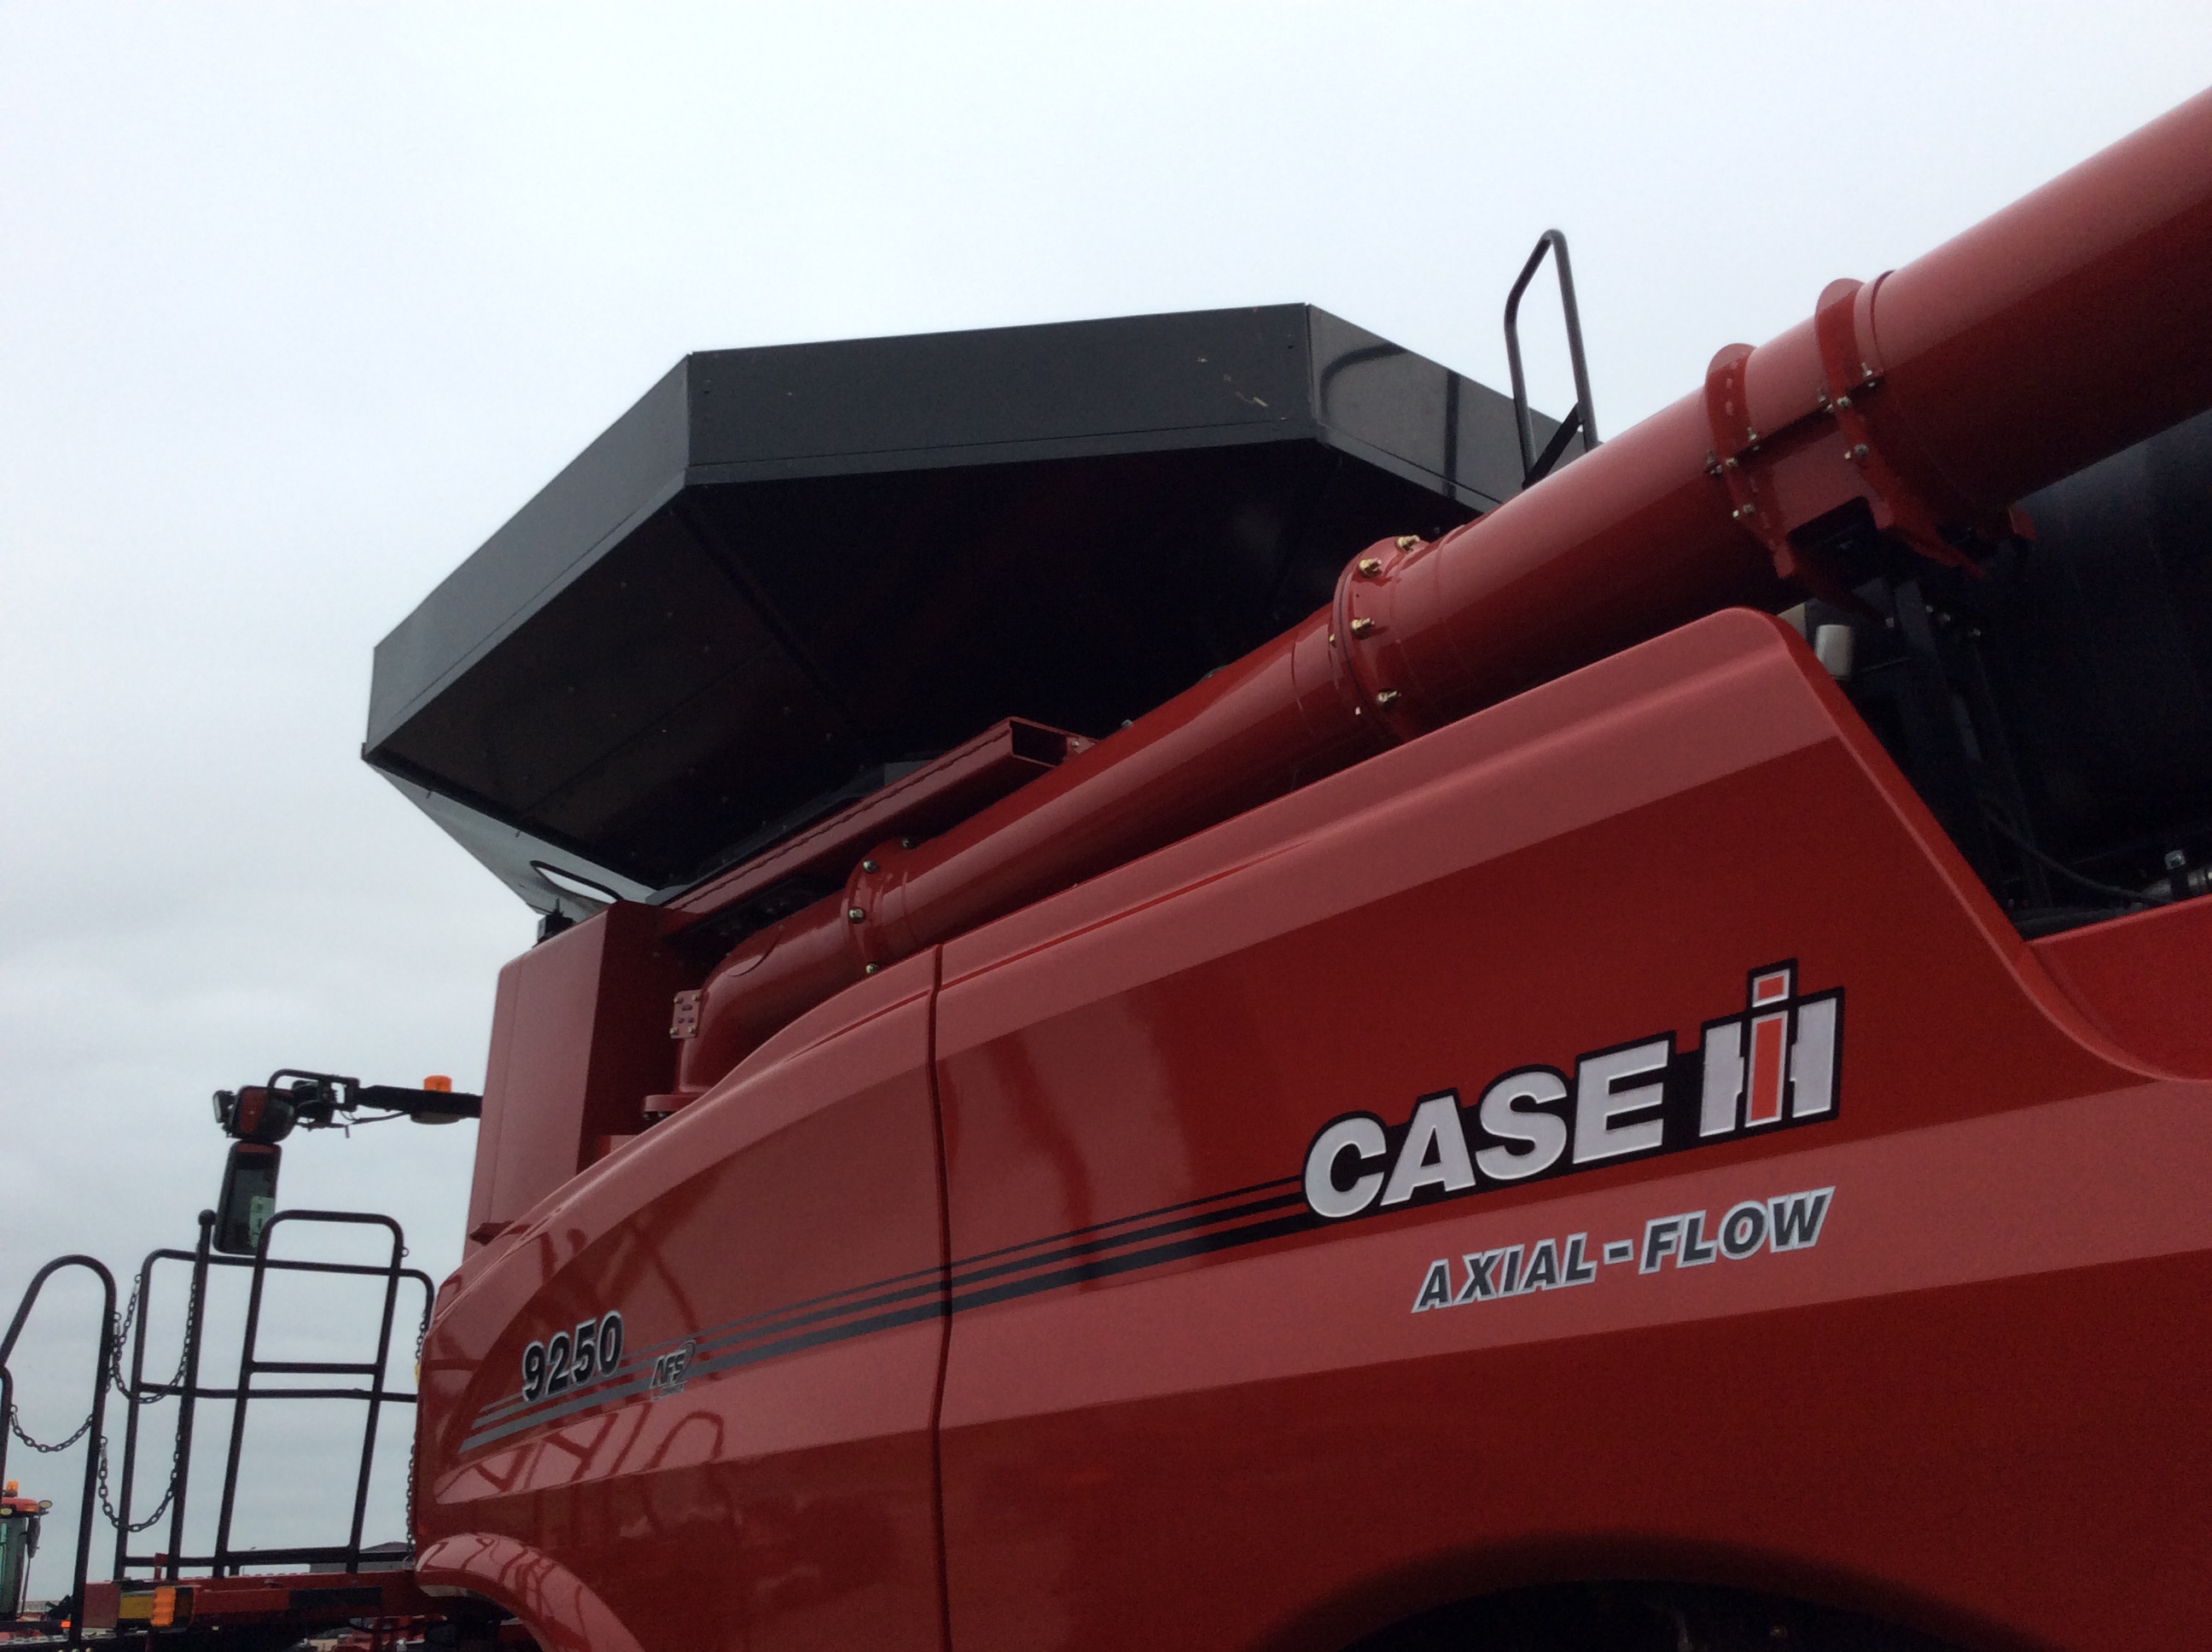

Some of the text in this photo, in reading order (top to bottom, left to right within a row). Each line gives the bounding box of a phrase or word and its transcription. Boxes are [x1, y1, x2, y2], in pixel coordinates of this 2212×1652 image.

[1304, 1038, 1670, 1218] CASE
[1411, 1186, 1836, 1313] AXIAL-FLOW
[521, 1310, 624, 1402] 9250
